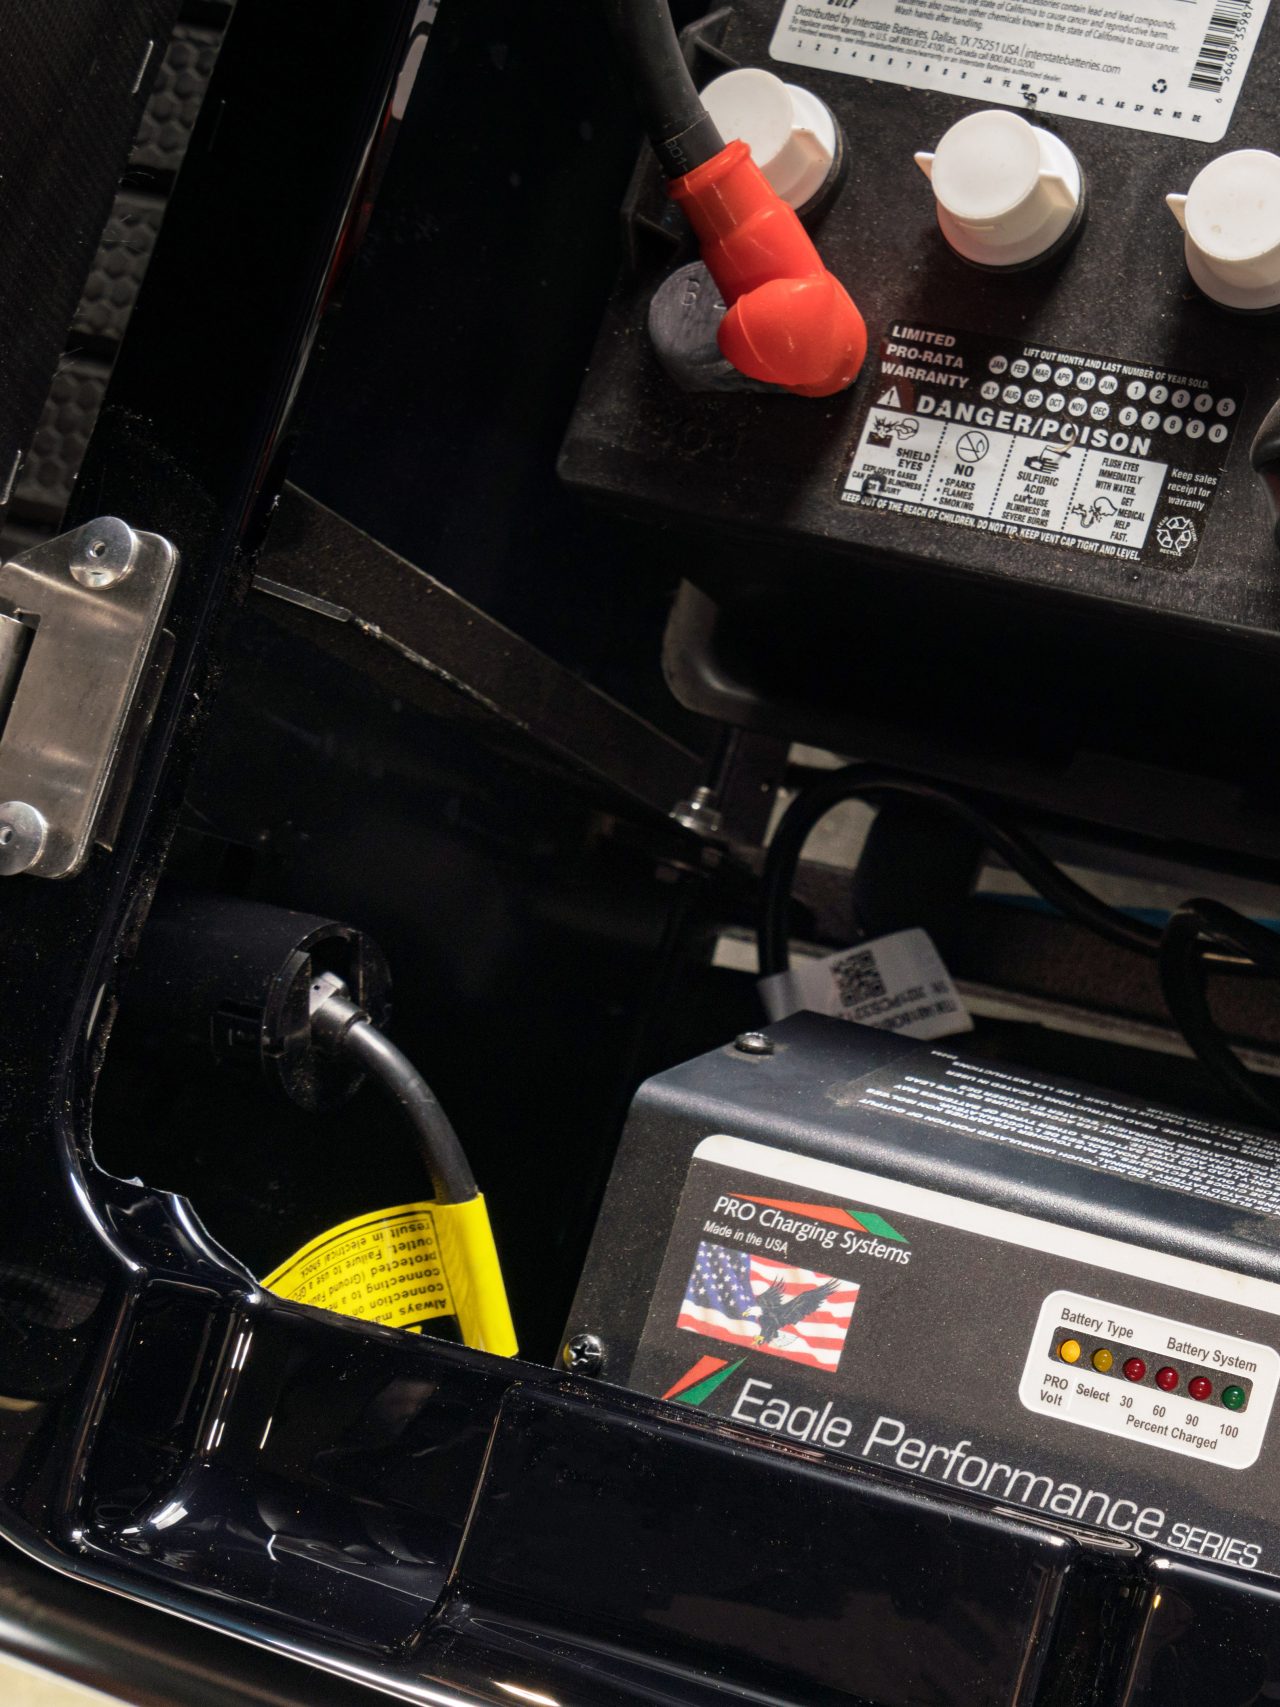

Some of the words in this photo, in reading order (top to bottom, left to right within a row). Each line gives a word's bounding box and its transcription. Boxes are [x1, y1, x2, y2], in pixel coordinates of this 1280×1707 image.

[890, 325, 956, 347] LIMITED
[885, 343, 965, 368] PRO-RATA
[879, 360, 969, 389] WARRANTY
[1023, 347, 1040, 358] LIFT
[1039, 350, 1057, 361] OUT
[1056, 353, 1084, 366] MONTH
[1084, 358, 1101, 369] AND
[1101, 361, 1121, 373] LAST
[1121, 365, 1155, 379] NUMBER
[1154, 371, 1166, 381] OF
[1166, 373, 1187, 385] YEAR
[1187, 377, 1210, 389] SOLD.
[915, 393, 1151, 459] DANGER/POISON
[895, 447, 932, 463] SHIELD
[897, 457, 923, 471] EYES
[953, 463, 974, 478] NO
[1101, 457, 1123, 469] FLUSH
[1121, 461, 1139, 473] EYES
[944, 477, 975, 491] SPARKS
[1016, 470, 1059, 487] SULFURIC
[1097, 468, 1143, 485] IMMEDIATELY
[1170, 467, 1193, 481] Keep
[1193, 472, 1217, 485] sales
[941, 486, 973, 501] FLAMES
[1023, 482, 1045, 496] ACID
[1094, 479, 1113, 491] WITH
[1111, 482, 1137, 496] WATER.
[1166, 480, 1198, 496] receipt
[1197, 487, 1211, 498] for
[938, 496, 974, 511] SMOKING
[1120, 497, 1134, 507] GET
[1167, 494, 1204, 511] warranty
[1117, 507, 1145, 521] MEDICAL
[1113, 519, 1130, 530] HELP
[1109, 530, 1129, 542] FAST.
[1195, 1189, 1252, 1207] ELECTRIC
[703, 1220, 733, 1238] Made
[734, 1229, 744, 1240] in
[746, 1231, 763, 1246] the
[764, 1238, 789, 1253] USA
[713, 1196, 756, 1221] PRO
[759, 1208, 839, 1249] Charging
[839, 1231, 912, 1265] Systems
[399, 1298, 447, 1315] Always
[1060, 1307, 1104, 1332] Battery
[1107, 1320, 1134, 1340] Type
[1167, 1336, 1210, 1361] Battery
[1212, 1350, 1258, 1373] System
[1043, 1373, 1069, 1390] PRO
[1039, 1389, 1063, 1407] Volt
[1075, 1383, 1111, 1403] Select
[1119, 1395, 1134, 1409] 30
[1152, 1404, 1166, 1418] 60
[1185, 1413, 1200, 1427] 90
[1219, 1423, 1239, 1439] 100
[1126, 1414, 1169, 1436] Percent
[1171, 1426, 1218, 1451] Charged
[730, 1378, 852, 1448] Eagle
[862, 1415, 1167, 1540] Performance
[1165, 1522, 1263, 1570] SERIES
